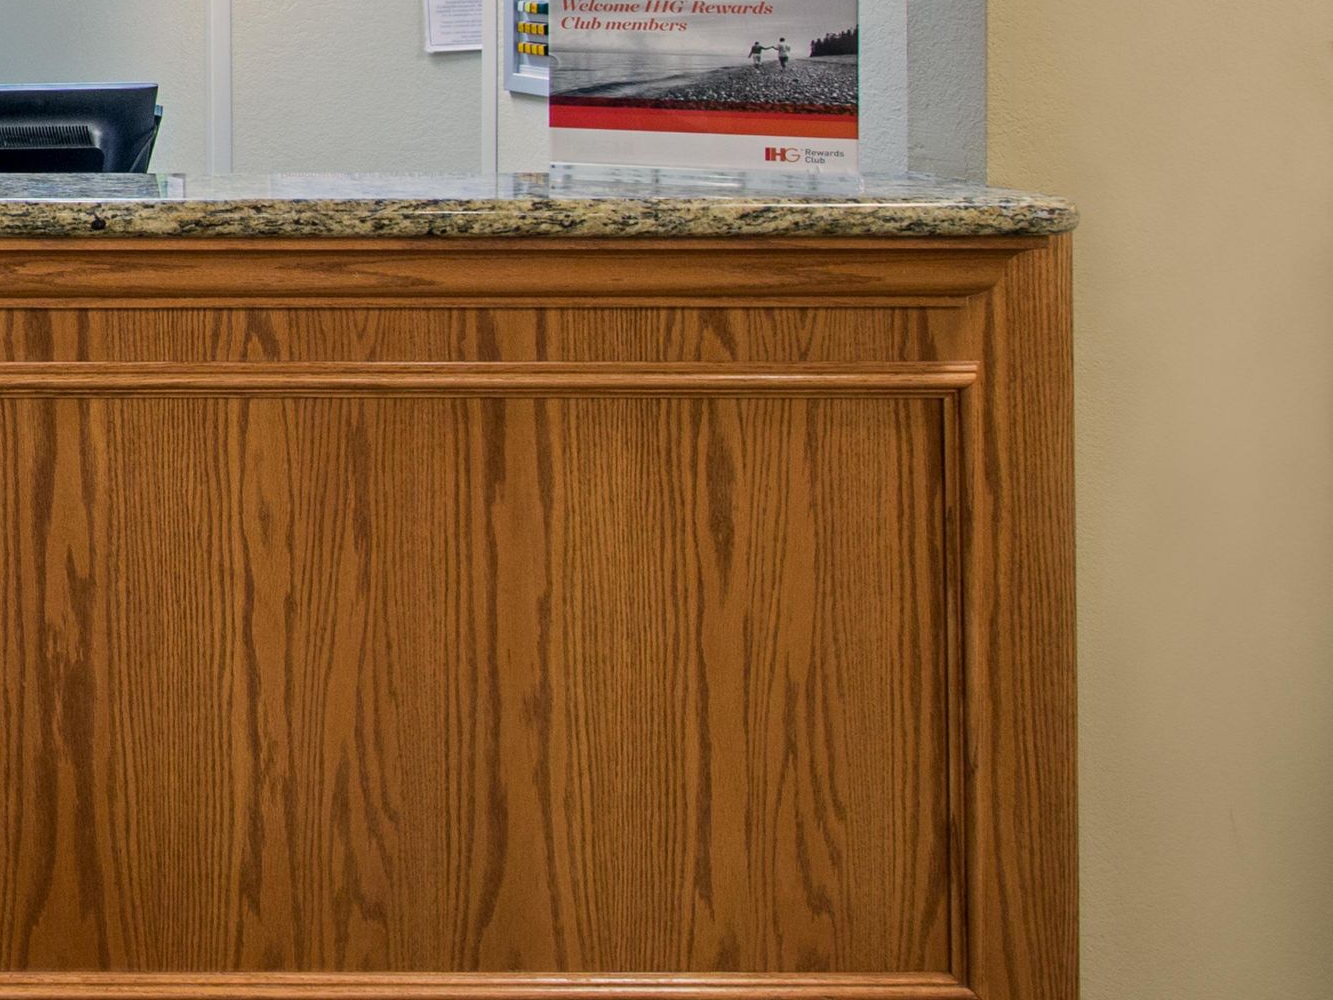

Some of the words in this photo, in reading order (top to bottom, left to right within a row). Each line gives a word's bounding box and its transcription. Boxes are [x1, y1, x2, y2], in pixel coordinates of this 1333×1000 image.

[644, 0, 685, 13] IHG
[691, 1, 774, 15] Rewards
[561, 16, 602, 30] Club
[604, 18, 689, 31] members
[765, 147, 801, 163] IHG
[805, 149, 845, 157] Rewards
